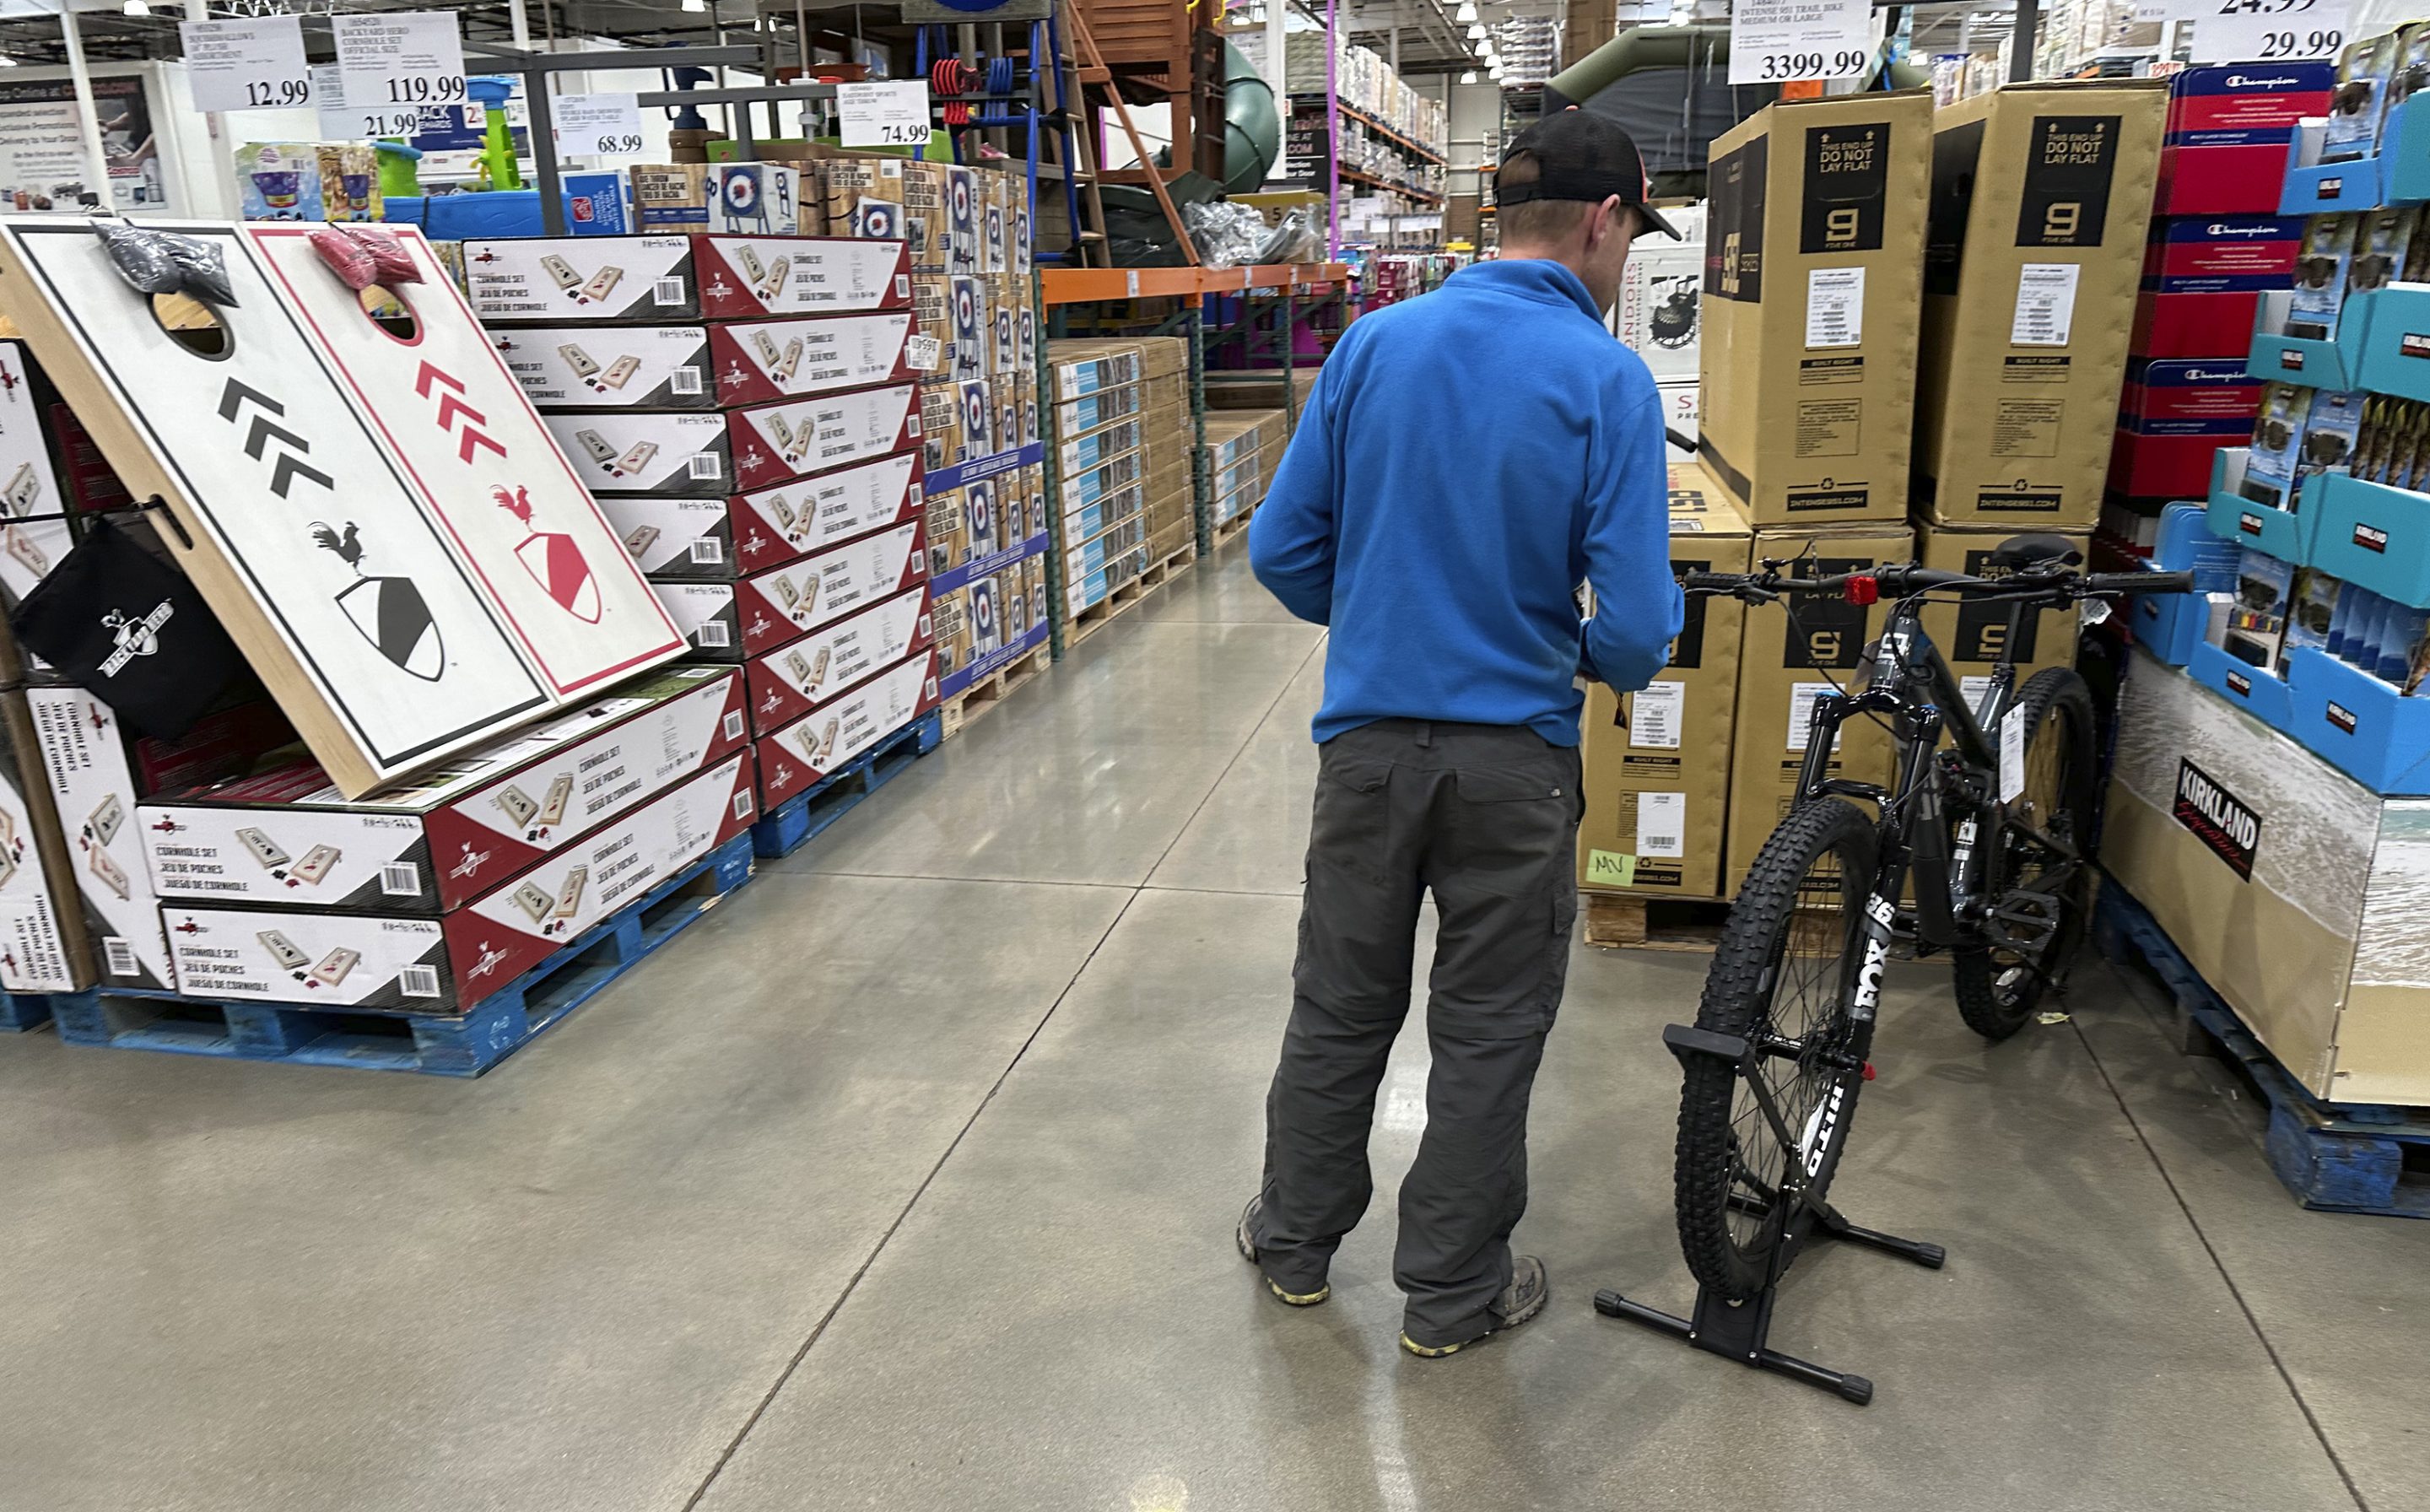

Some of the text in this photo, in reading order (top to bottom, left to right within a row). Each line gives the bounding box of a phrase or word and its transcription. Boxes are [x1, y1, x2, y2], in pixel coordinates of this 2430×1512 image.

[2258, 30, 2342, 58] 29.99
[1760, 50, 1866, 79] 3399.99
[386, 75, 466, 103] 119.99
[2226, 76, 2299, 89] Champion
[246, 79, 309, 107] 12.99
[364, 113, 417, 137] 21.99
[881, 124, 929, 143] 74.99
[597, 134, 642, 153] 68.99
[2045, 141, 2102, 154] DO NOT
[1820, 148, 1873, 164] DO NOT
[2044, 154, 2099, 164] LAY FLAT
[1820, 160, 1872, 174] LAY FLAT
[2206, 224, 2280, 237] Champion
[1623, 262, 1637, 348] ONDORS
[2184, 369, 2247, 382] Champio
[2179, 765, 2257, 850] KIRKLAND
[155, 846, 218, 858] CORNHOLE SET
[159, 863, 224, 874] JEU DE POCHES
[163, 879, 194, 890] JUEGO
[203, 880, 250, 892] CORNHOLE
[1865, 891, 1896, 925] 36
[179, 947, 239, 958] CORNHOLE SET
[183, 964, 245, 975] JEU DE POCHES
[1854, 937, 1891, 1010] FOX
[186, 979, 215, 990] JUEGO
[225, 980, 270, 992] CORNHOLE
